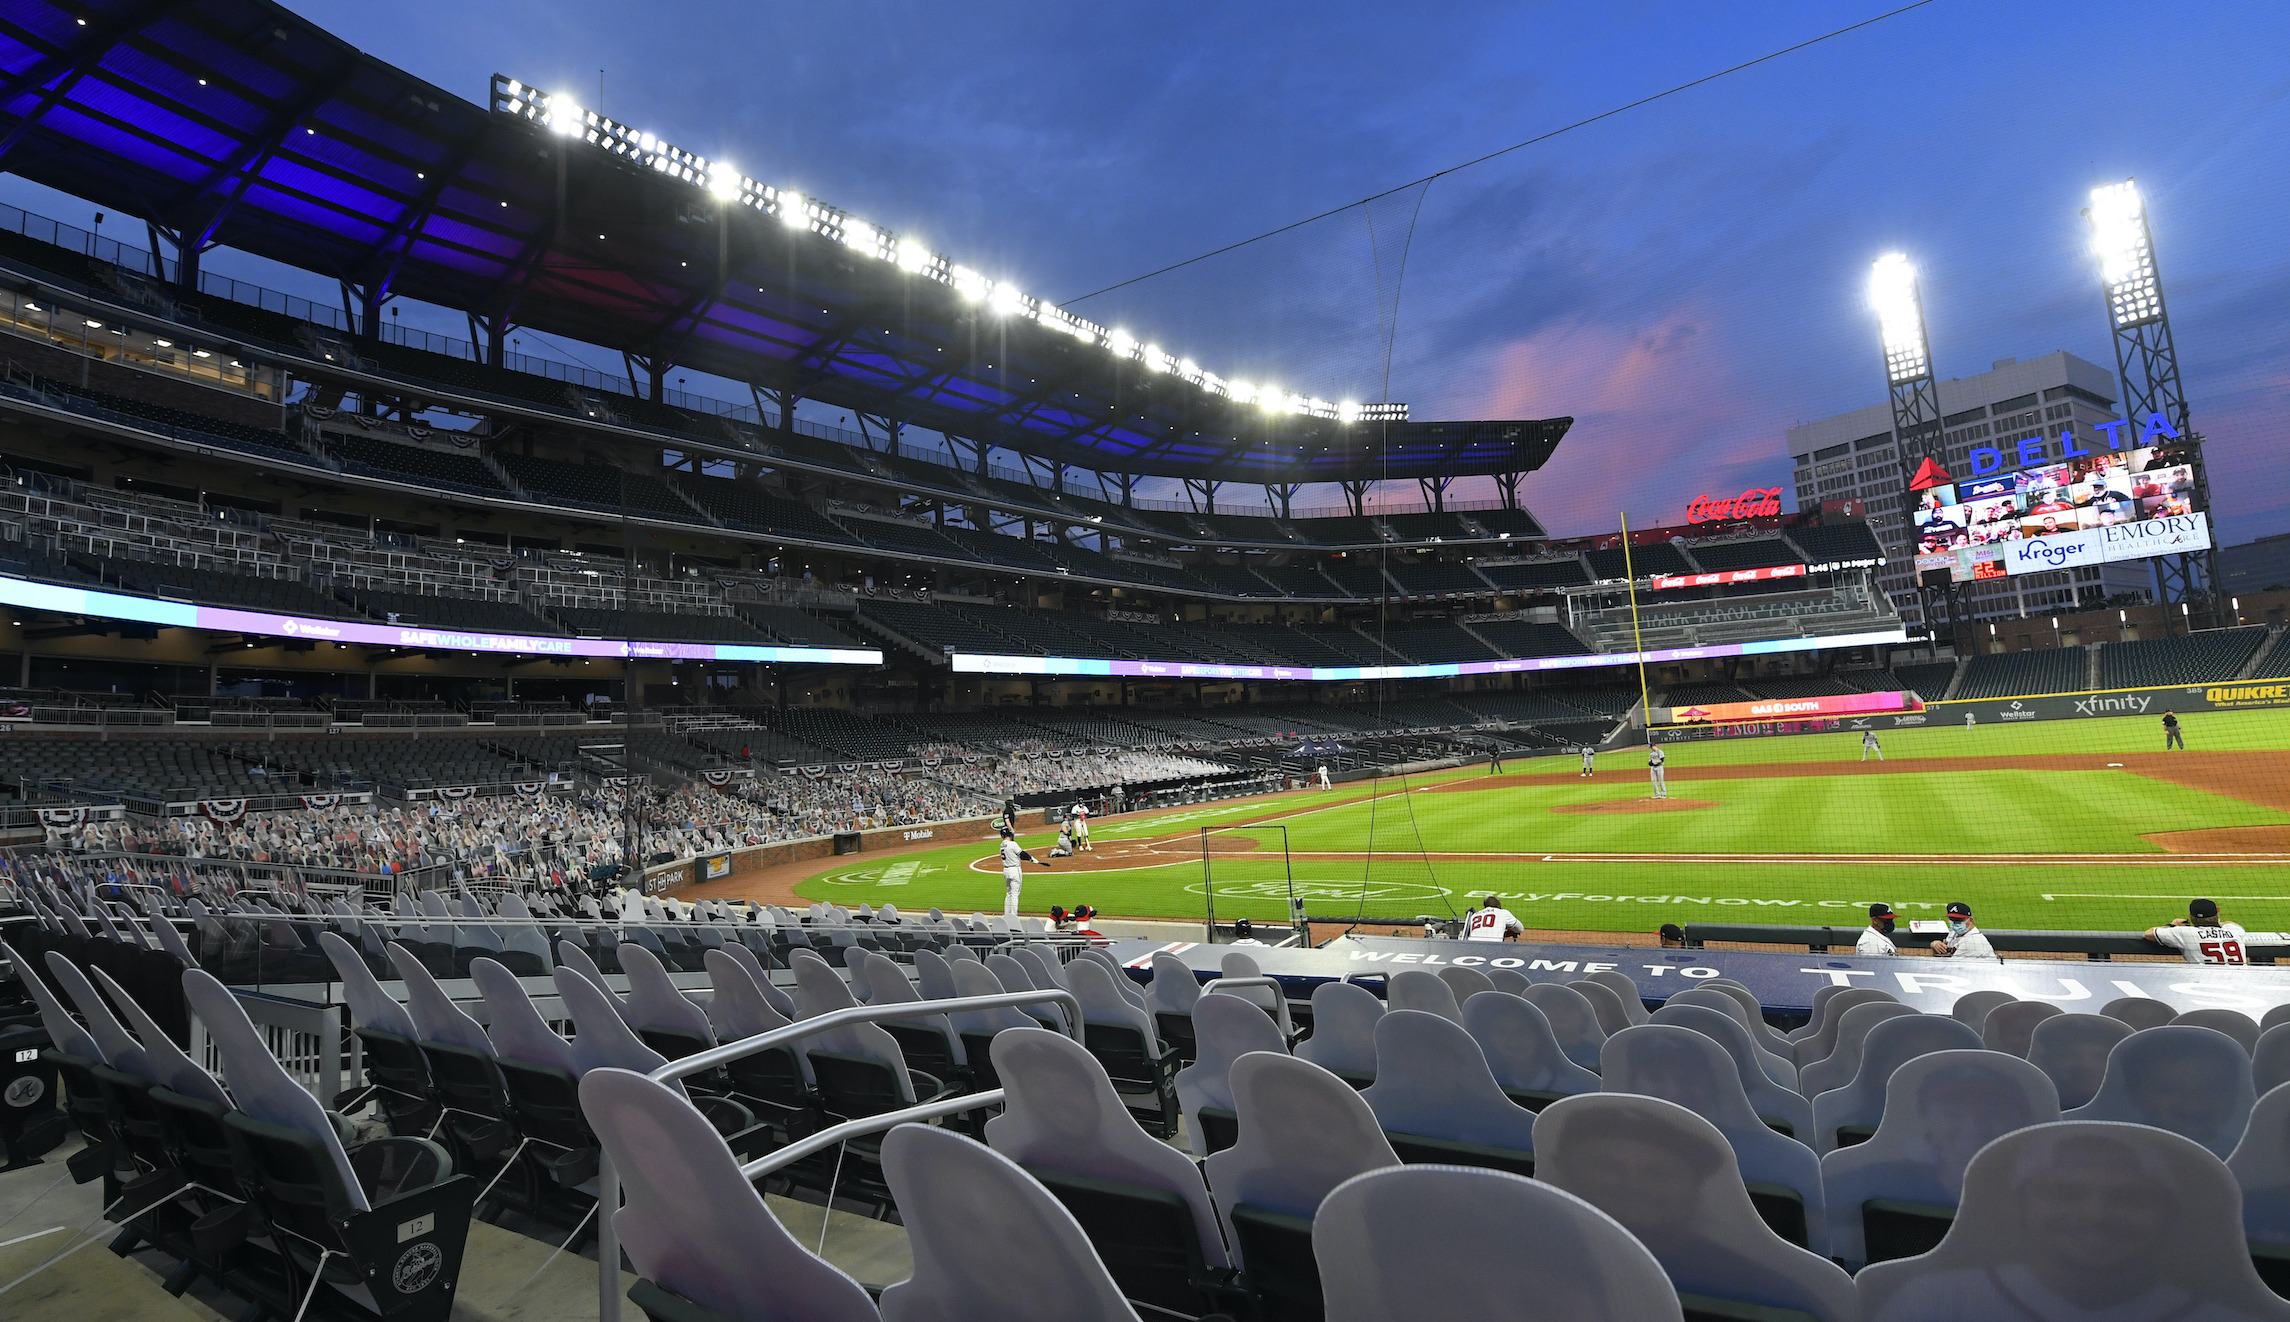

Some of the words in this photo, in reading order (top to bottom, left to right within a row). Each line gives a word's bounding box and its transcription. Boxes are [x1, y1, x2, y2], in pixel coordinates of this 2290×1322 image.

[1970, 412, 2179, 475] DELTA
[2105, 514, 2199, 542] EMORY
[2018, 540, 2085, 565] Kroger
[1974, 562, 1994, 573] 22
[1975, 570, 2006, 579] MILLION
[1554, 586, 1566, 596] 42
[2206, 685, 2290, 702] QUIKRE
[1751, 705, 1772, 714] GAS
[1784, 702, 1819, 712] SOUTH
[2074, 694, 2151, 716] xfinity
[2000, 710, 2035, 718] Wellstar
[910, 829, 933, 840] Mobile
[666, 870, 684, 886] PARK
[1464, 890, 1947, 909] BuyFordNow.com
[1472, 914, 1496, 931] 20
[2198, 929, 2234, 940] CASTRO
[2199, 941, 2244, 966] 59
[1348, 951, 1619, 973] WELCOME
[1642, 965, 1720, 979] TO
[1800, 967, 2290, 1007] TRUIS
[20, 1051, 33, 1061] 12
[410, 1221, 423, 1234] 12
